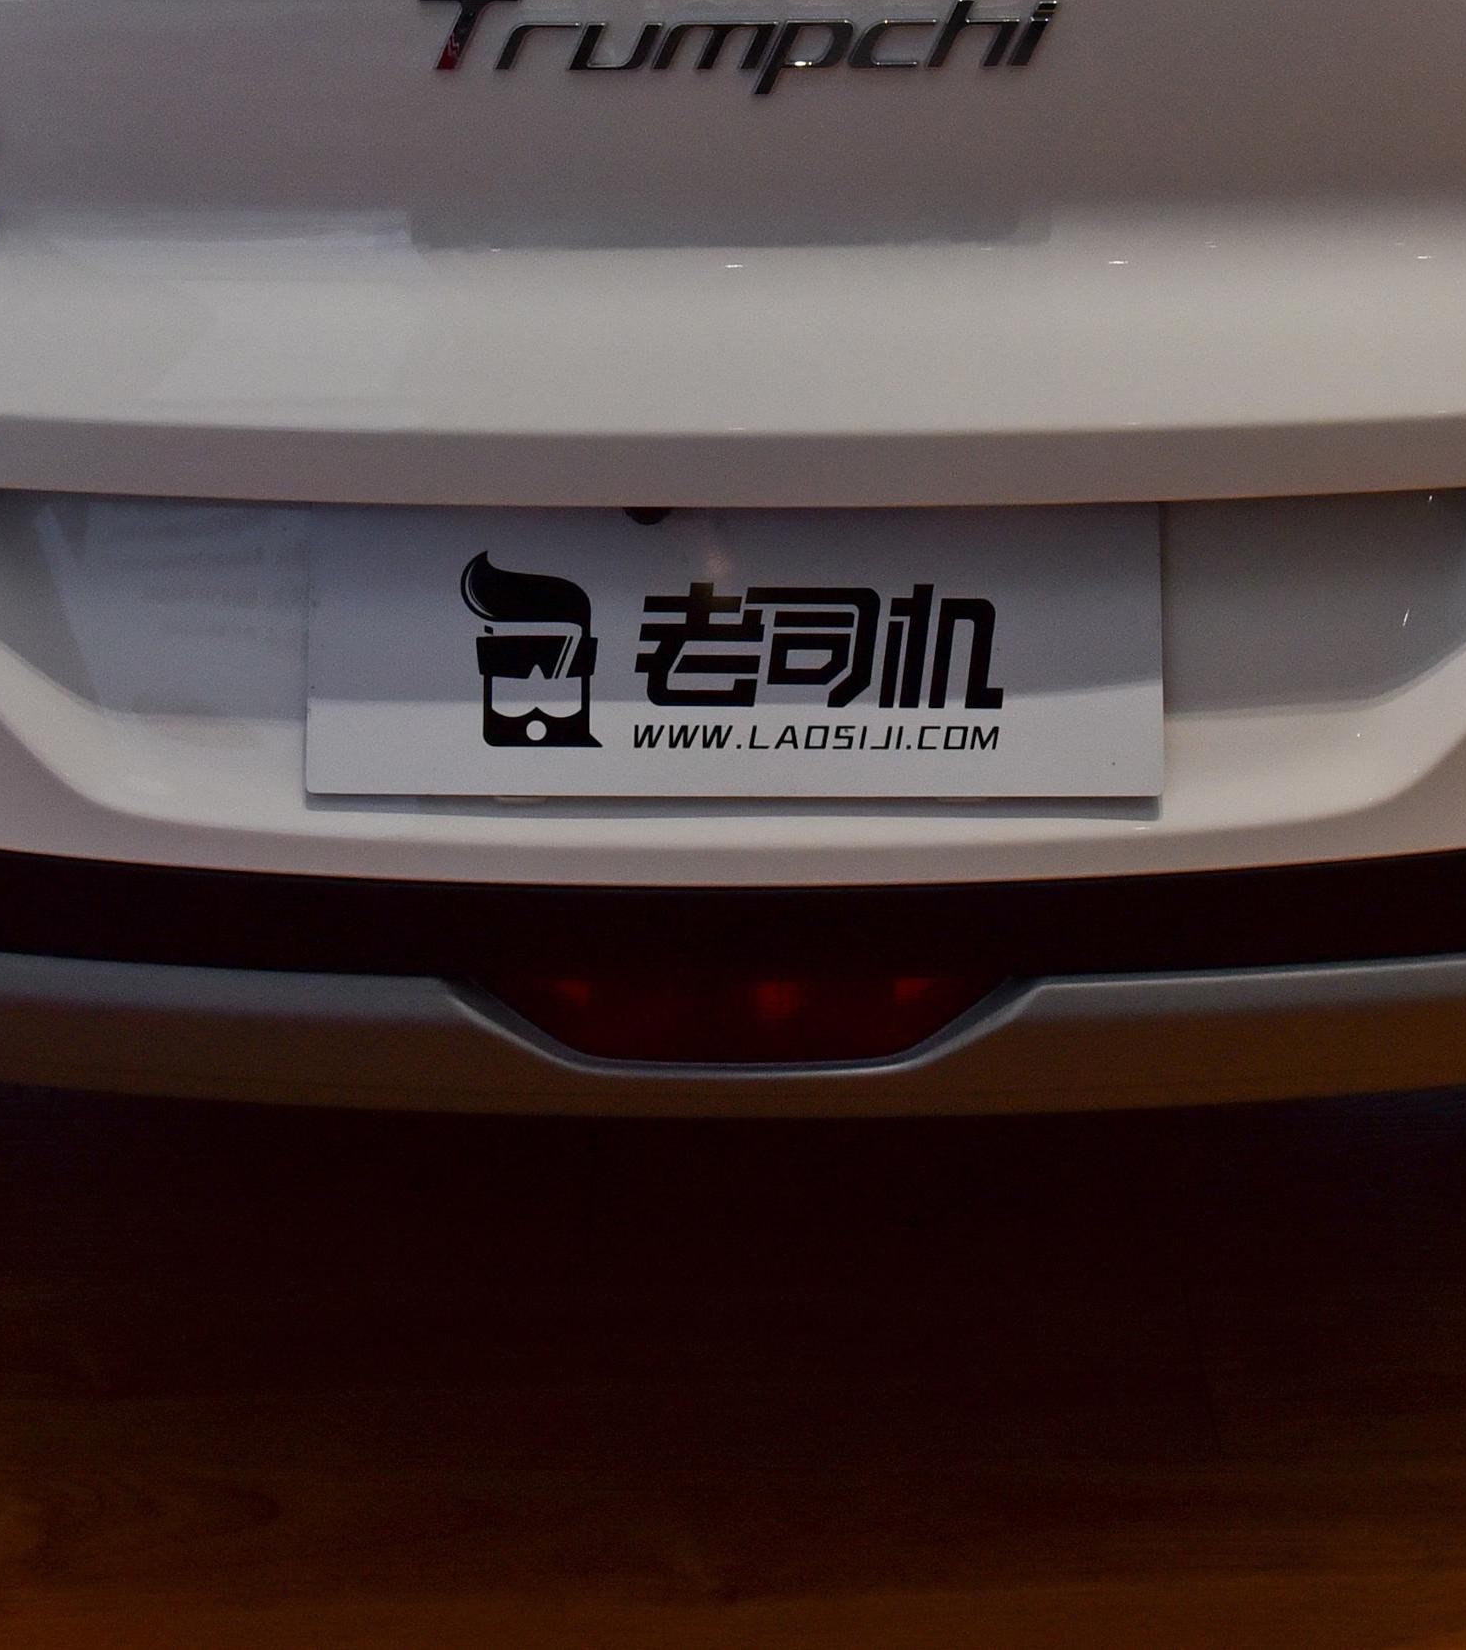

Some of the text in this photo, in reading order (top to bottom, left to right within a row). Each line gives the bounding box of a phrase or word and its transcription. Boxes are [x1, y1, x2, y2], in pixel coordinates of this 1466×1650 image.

[634, 582, 1005, 710] 老司机
[632, 723, 1001, 752] WWW.LAOSIJI.COM
